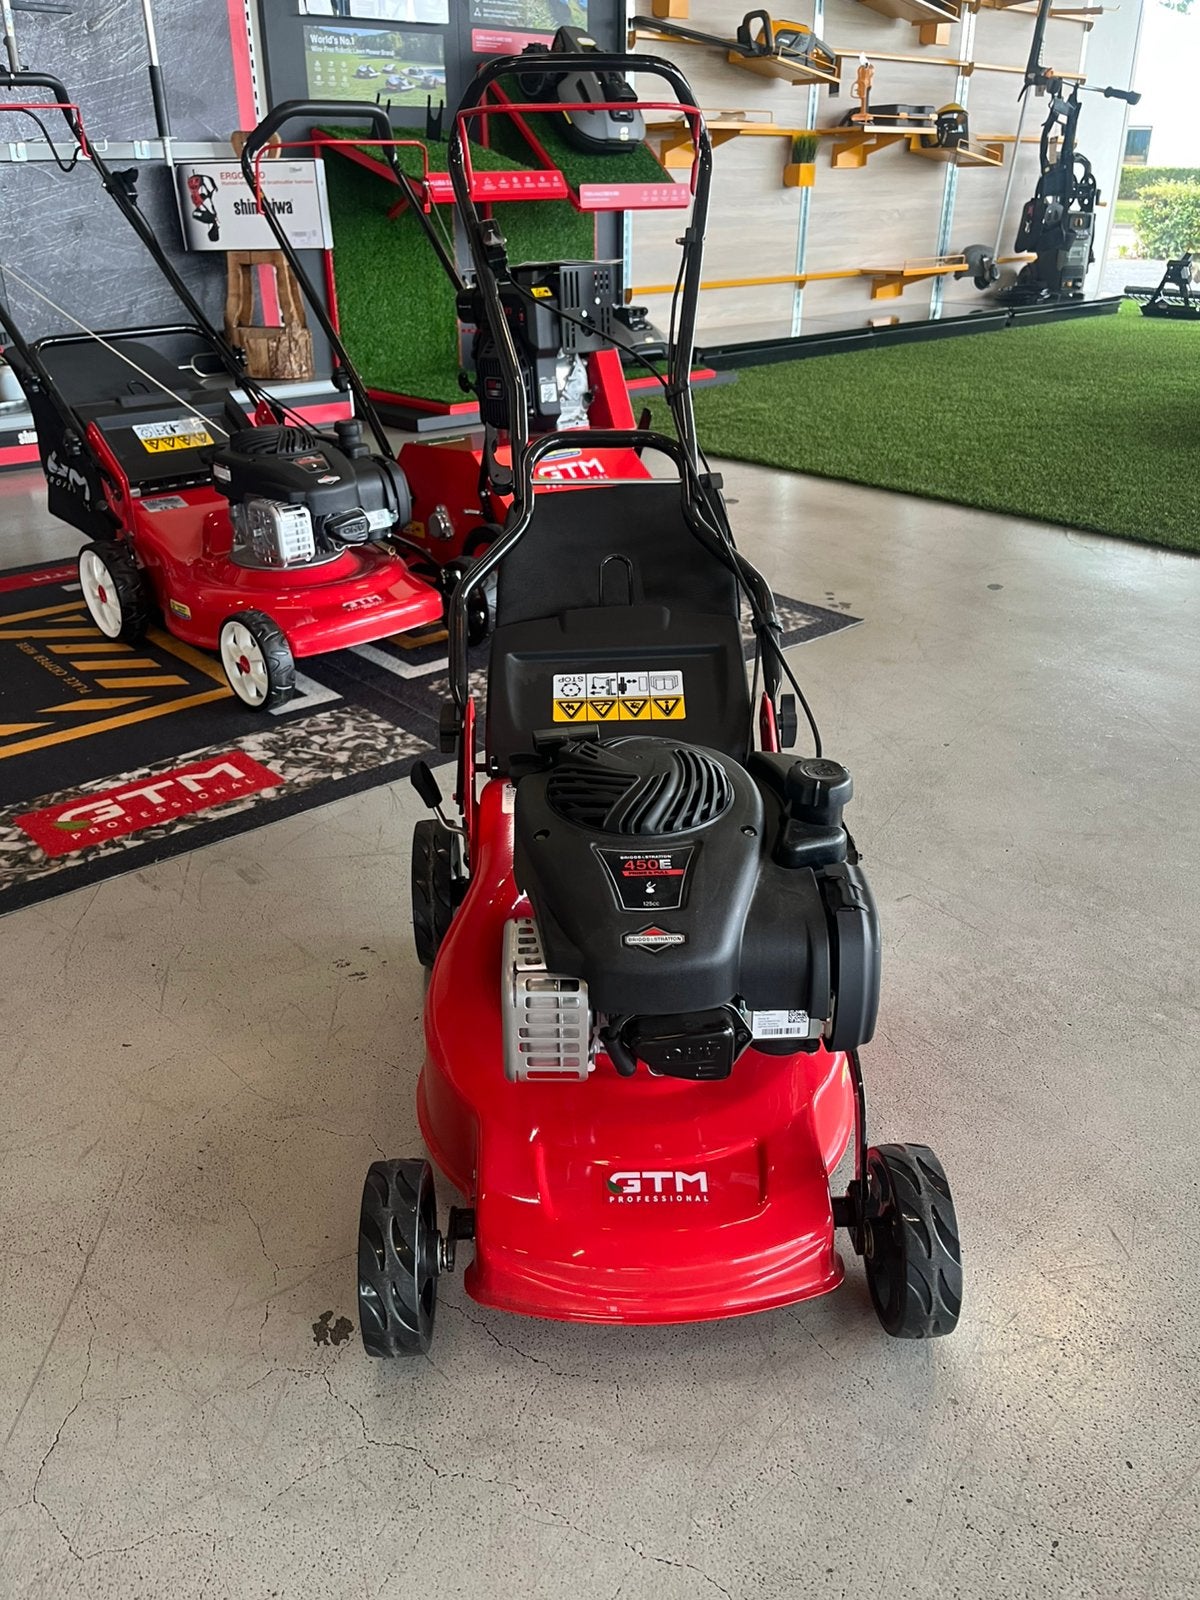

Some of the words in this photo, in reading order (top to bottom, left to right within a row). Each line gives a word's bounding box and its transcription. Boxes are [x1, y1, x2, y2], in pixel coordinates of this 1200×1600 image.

[309, 34, 338, 45] World's
[339, 36, 355, 46] No.1
[538, 458, 604, 480] GTM
[55, 762, 246, 830] GTM
[70, 778, 256, 840] PROFESSIONAL
[624, 859, 672, 871] 450E
[608, 1171, 708, 1194] GTM
[609, 1195, 709, 1203] PROFESSIONAL
